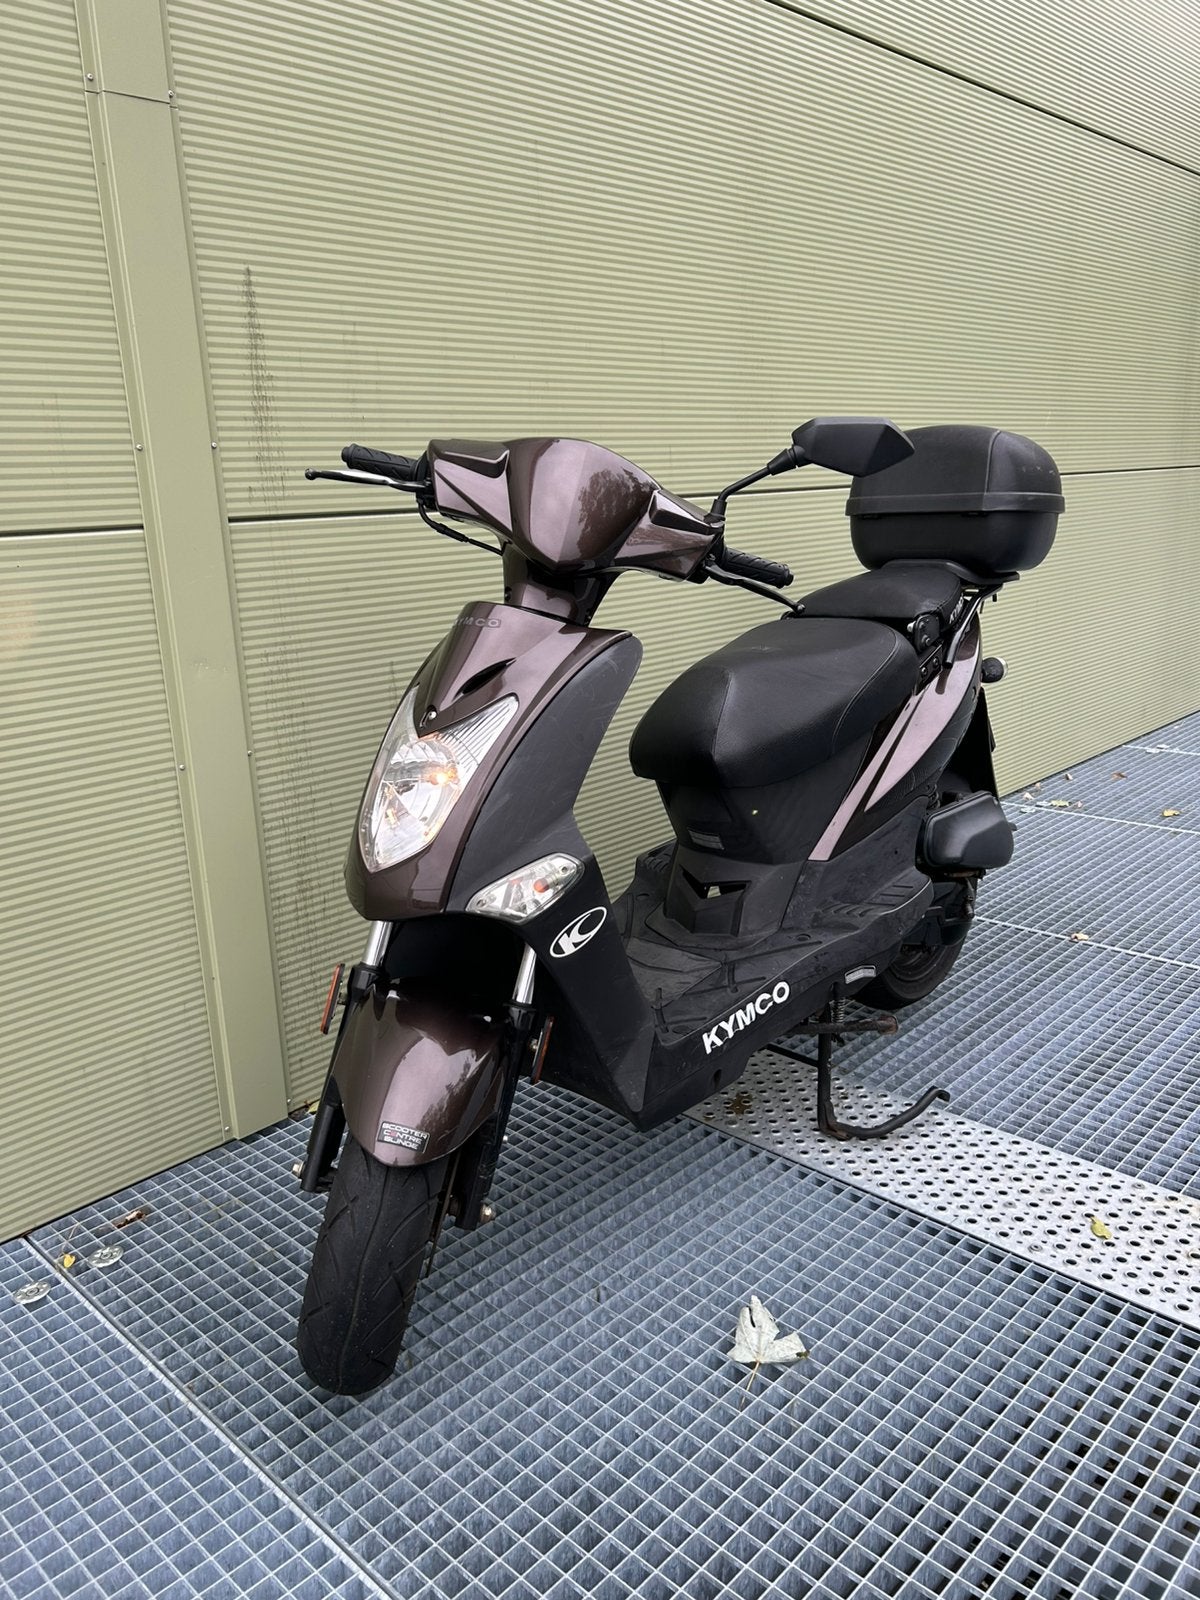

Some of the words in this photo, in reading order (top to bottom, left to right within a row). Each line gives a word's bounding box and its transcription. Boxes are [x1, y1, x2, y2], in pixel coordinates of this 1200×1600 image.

[702, 981, 790, 1055] KYMCO
[382, 1122, 428, 1140] SCOOTER
[383, 1129, 423, 1145] CENTRE
